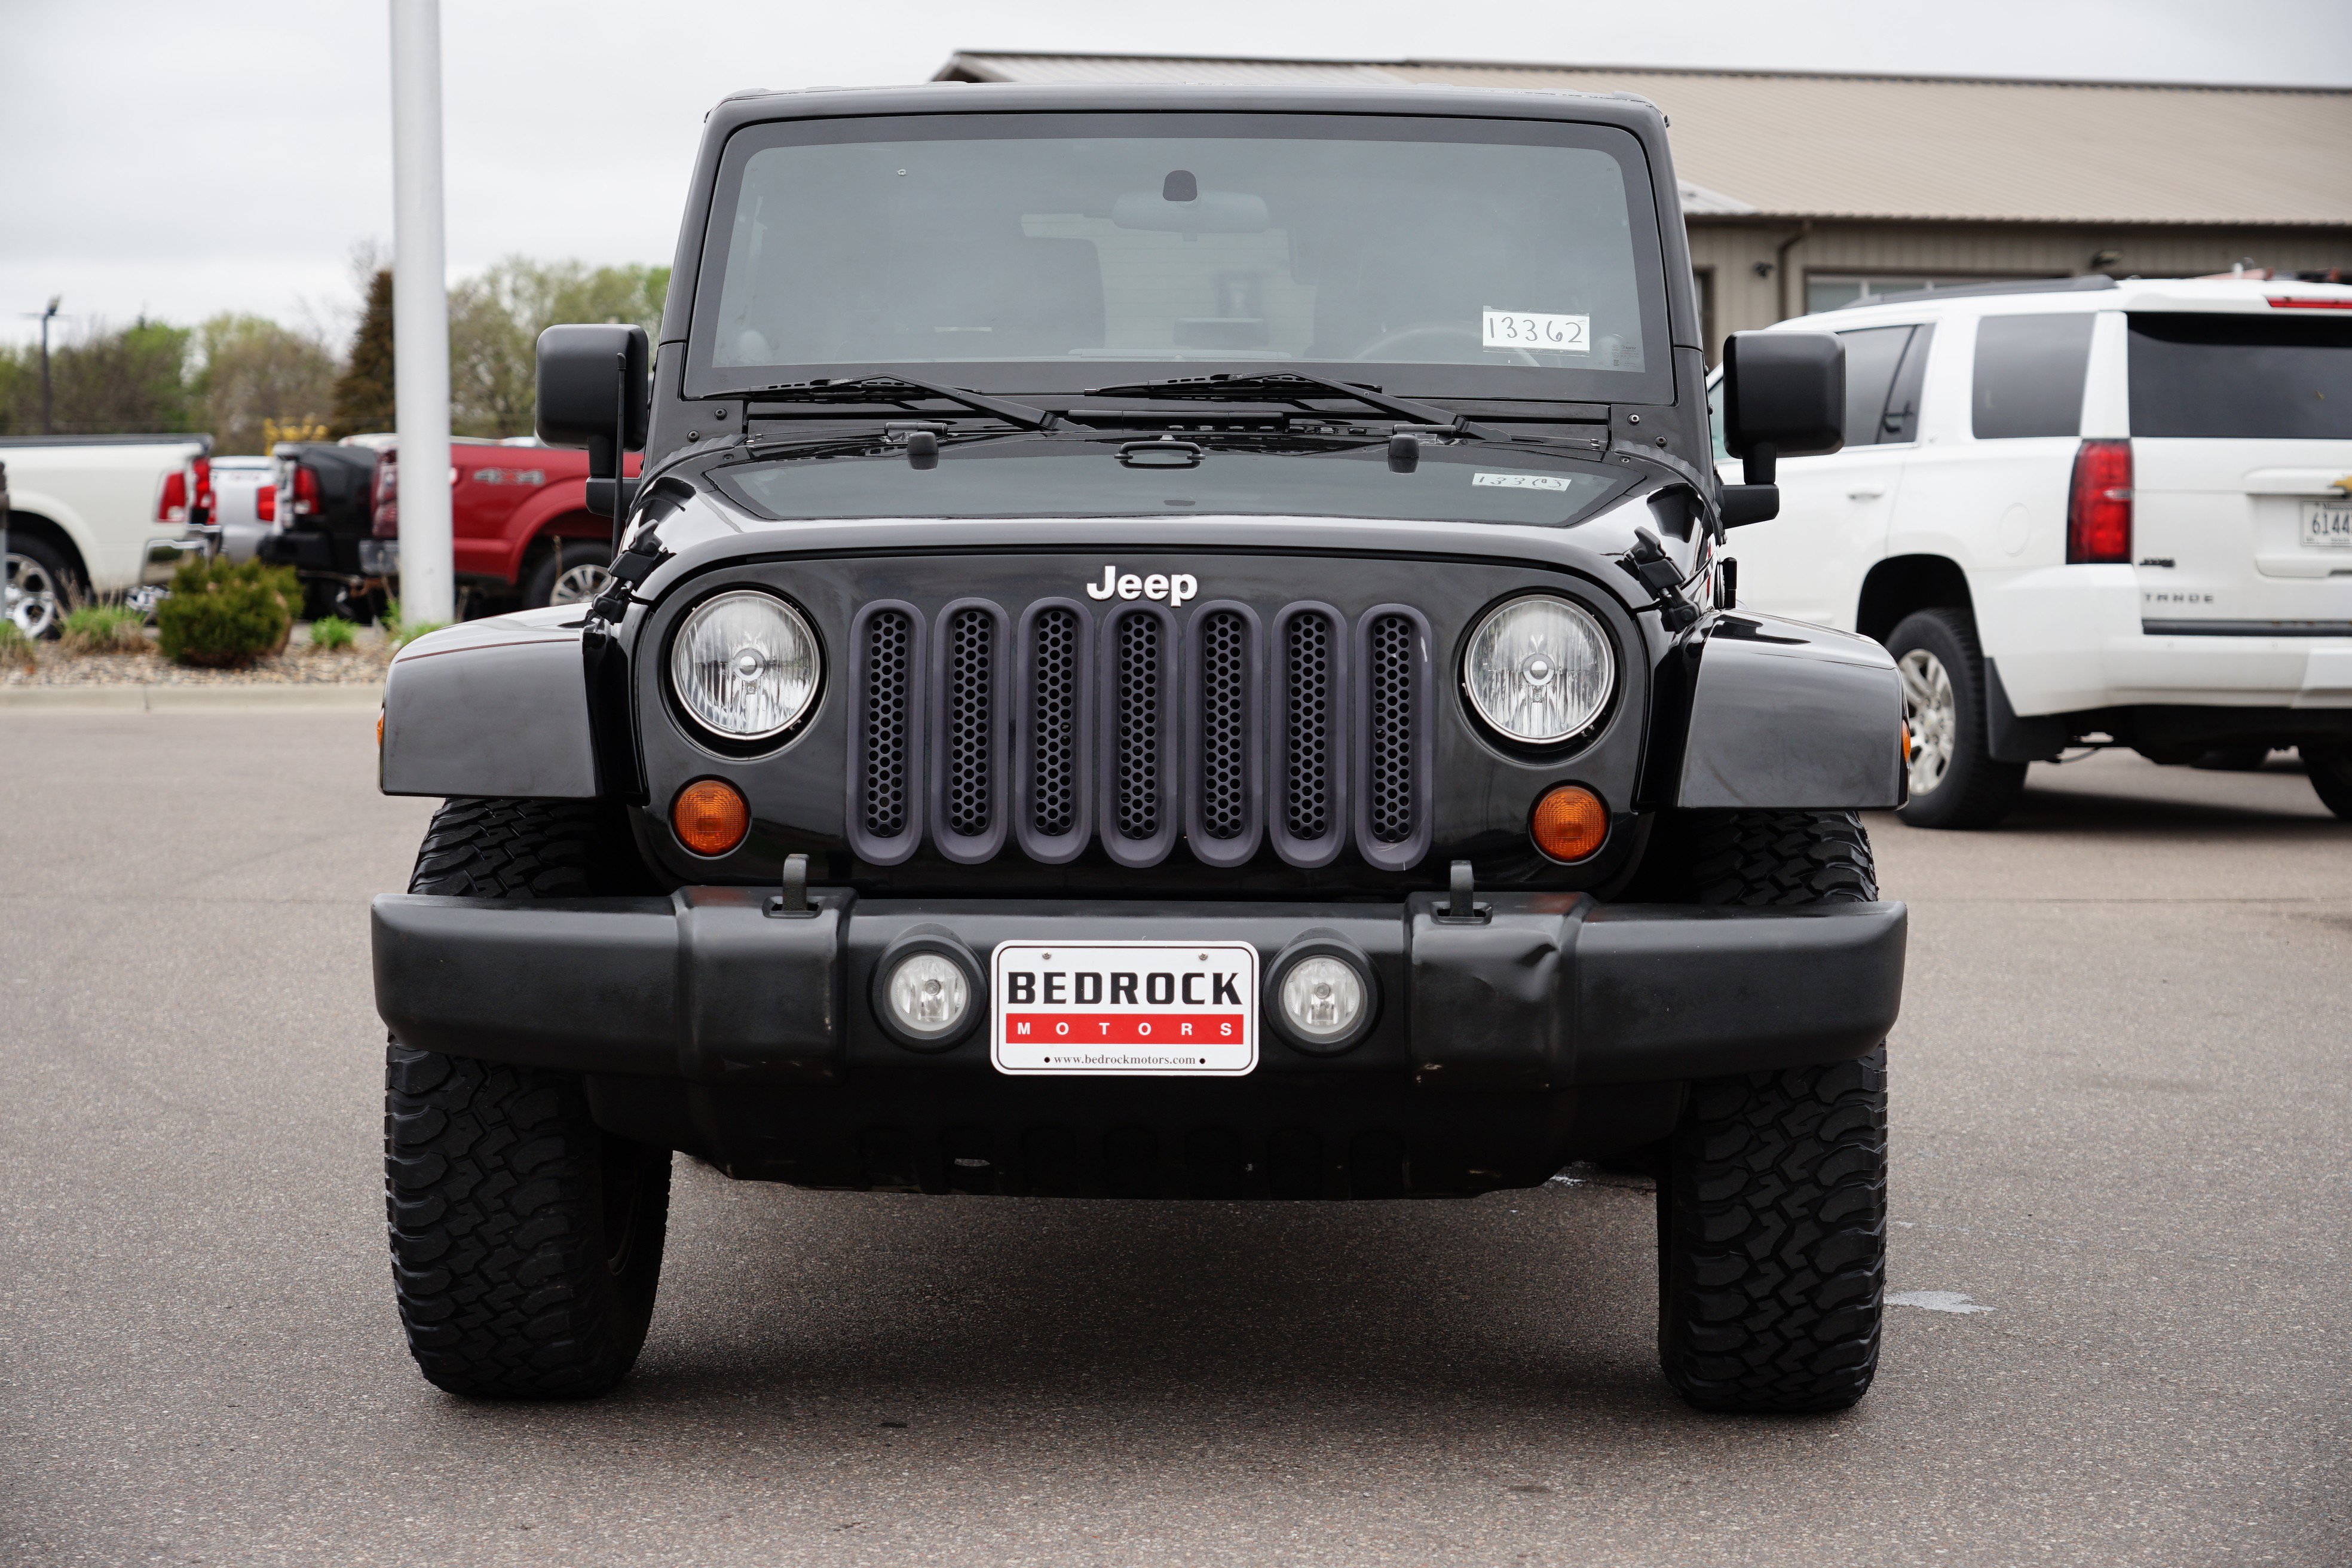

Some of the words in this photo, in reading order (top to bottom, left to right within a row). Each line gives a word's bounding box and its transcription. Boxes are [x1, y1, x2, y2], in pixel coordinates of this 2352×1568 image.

[1489, 316, 1583, 343] 13362
[2312, 512, 2352, 534] 6144
[1086, 565, 1198, 607] Jeep
[1007, 972, 1243, 1005] BEDROCK
[1017, 1022, 1232, 1036] MOTORS
[1054, 1054, 1196, 1065] www.bedrockmotors.com
